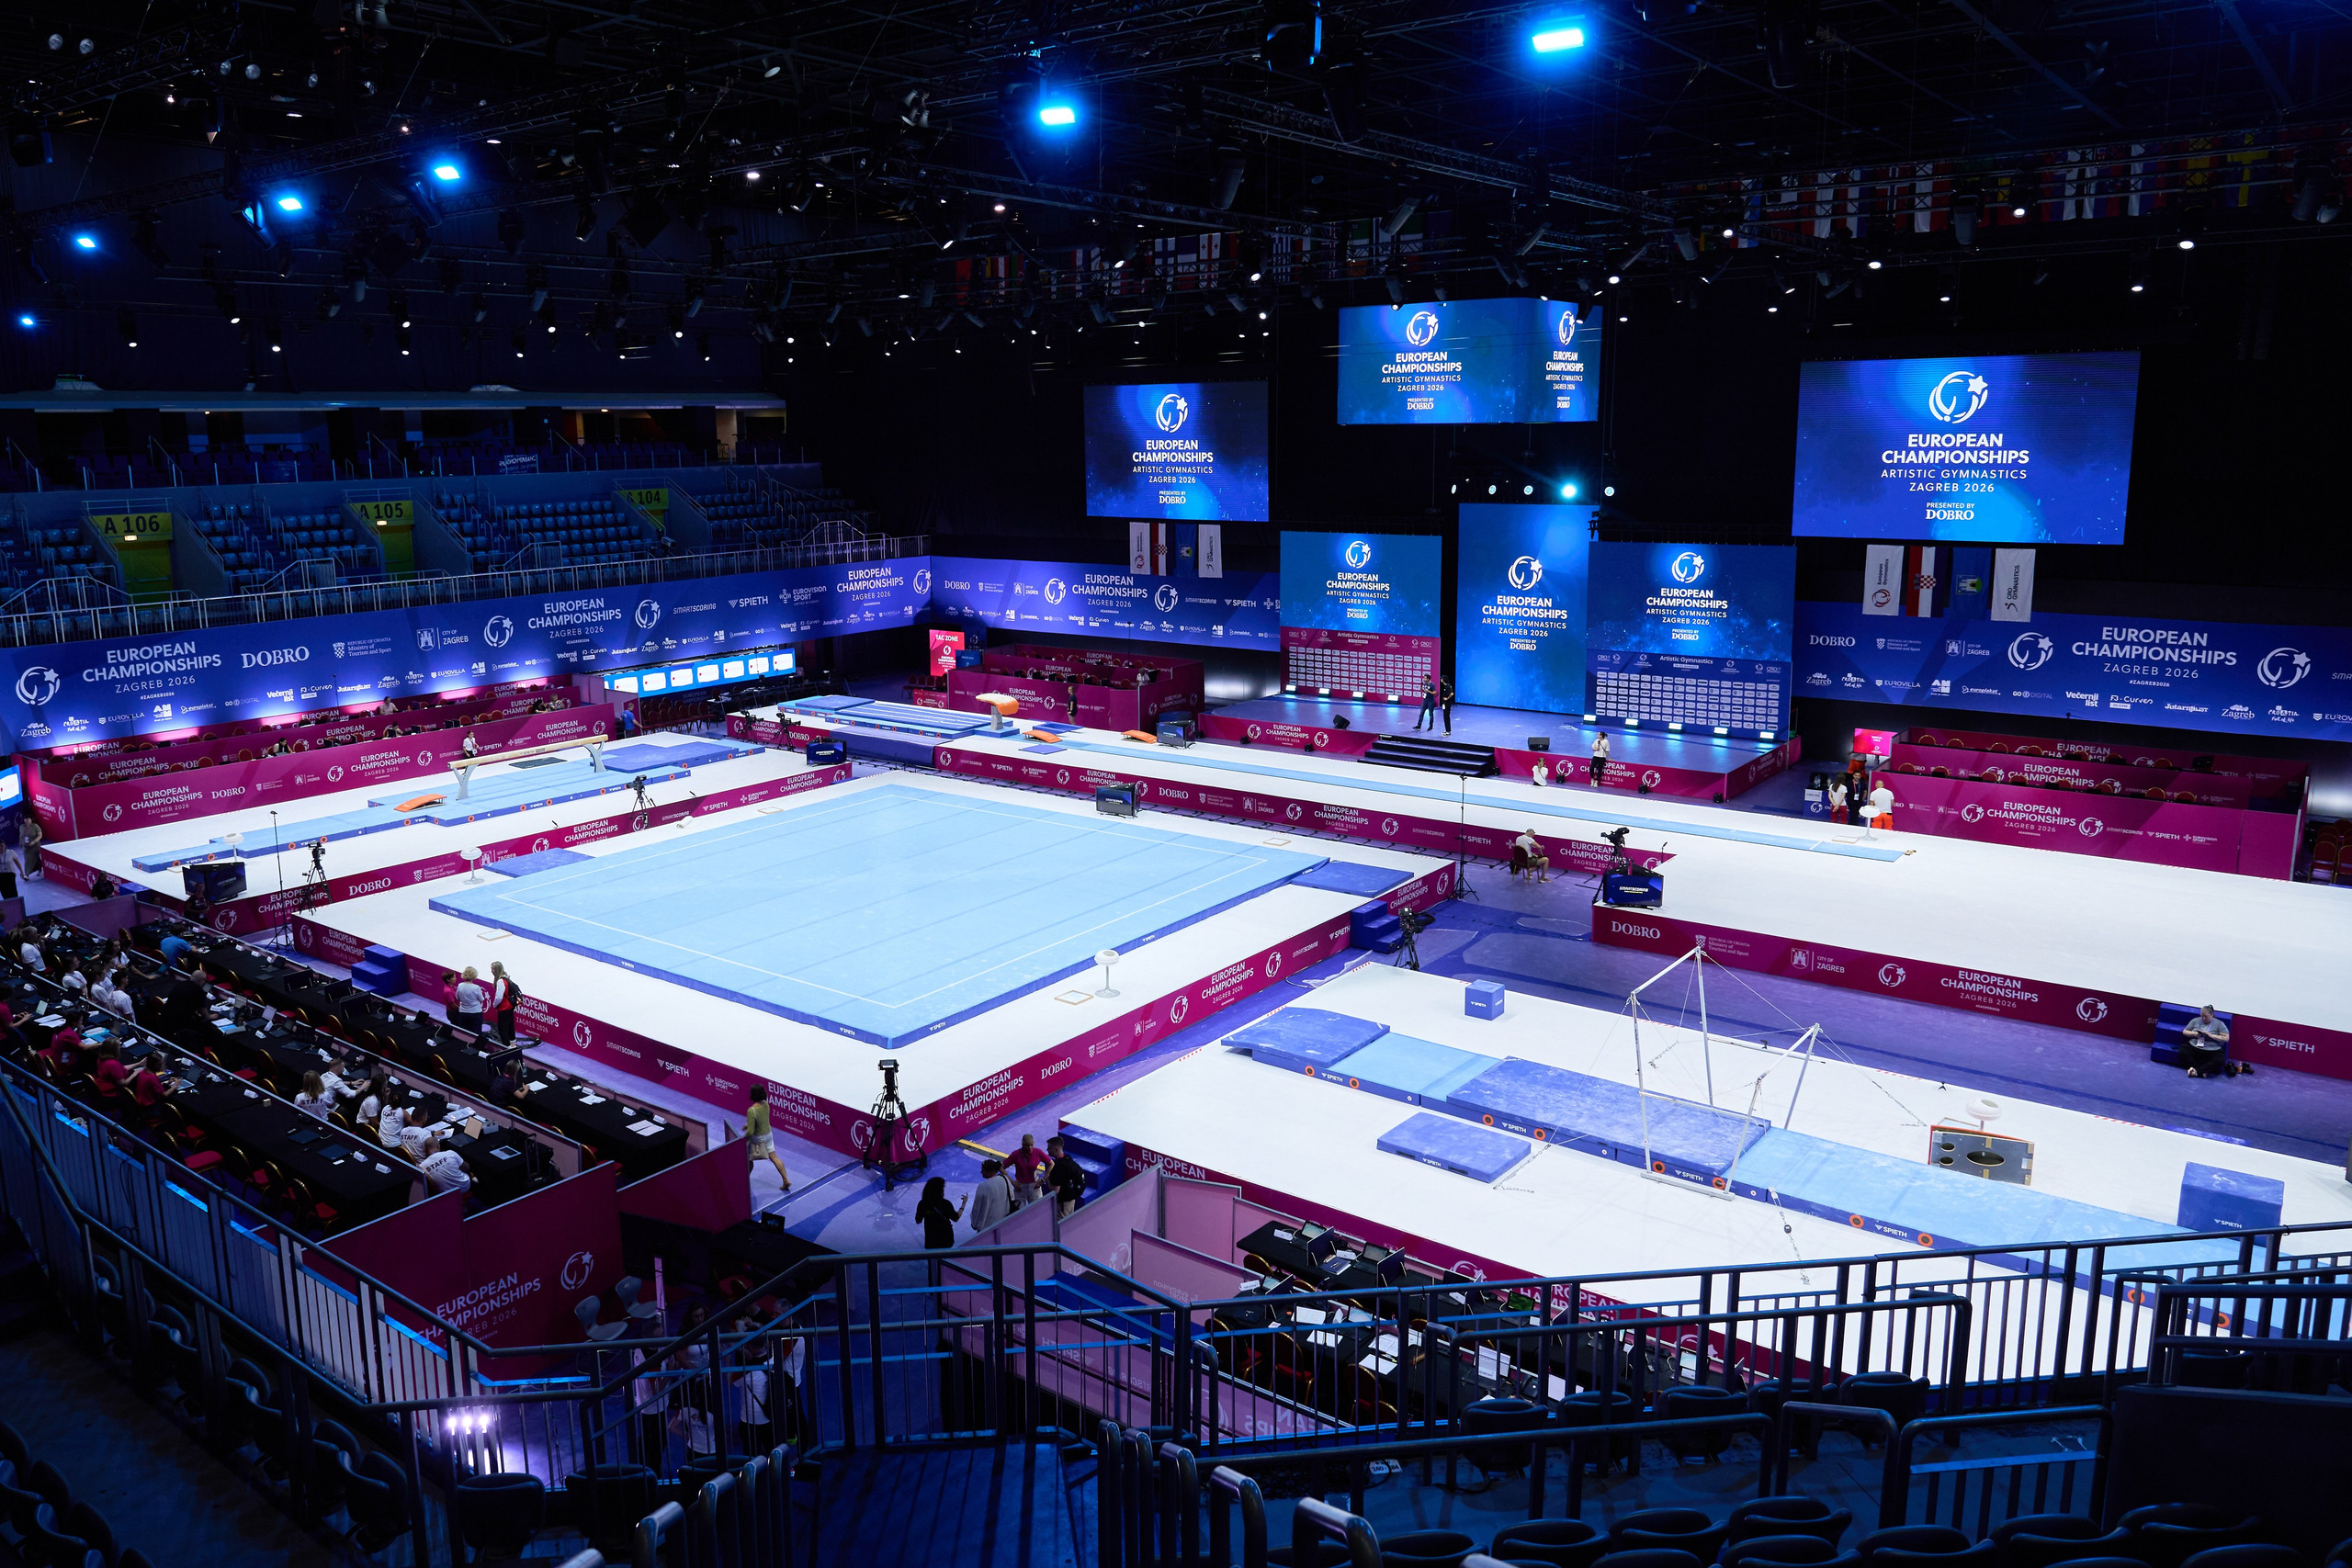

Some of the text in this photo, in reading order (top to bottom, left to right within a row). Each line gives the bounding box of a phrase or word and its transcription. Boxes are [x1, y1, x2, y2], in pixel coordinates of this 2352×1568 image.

[1396, 352, 1448, 363] EUROPEAN
[1382, 362, 1462, 374] CHAMPIONSHIPS
[1147, 440, 1198, 450] EUROPEAN
[1908, 434, 2003, 447] EUROPEAN
[1132, 452, 1214, 463] CHAMPIONSHIPS
[1882, 450, 2030, 464] CHAMPIONSHIPS
[1882, 468, 2027, 479] ARTISTIC GYMNASTICS
[1909, 483, 1995, 492] ZAGREB 2026
[638, 491, 661, 504] 104
[1159, 496, 1186, 504] DOBRO
[359, 503, 403, 520] A 105
[1926, 509, 1974, 520] DOBRO
[105, 514, 161, 535] A 106
[848, 568, 892, 581] EUROPEAN
[1085, 574, 1134, 586] EUROPEAN
[1338, 572, 1378, 581] EUROPEAN
[837, 577, 904, 592] CHAMPIONSHIPS
[944, 581, 970, 590] DOBRO
[1072, 584, 1148, 598] CHAMPIONSHIPS
[1327, 581, 1390, 591] CHAMPIONSHIPS
[794, 593, 812, 602] SPORT
[1661, 588, 1713, 599] EUROPEAN
[544, 598, 605, 614] EUROPEAN
[739, 595, 769, 607] SPIETH
[1233, 599, 1256, 608] SPIETH
[1498, 595, 1552, 607] EUROPEAN
[1646, 597, 1728, 609] CHAMPIONSHIPS
[673, 603, 717, 615] SMARTSCORING
[1482, 606, 1567, 619] CHAMPIONSHIPS
[1646, 608, 1727, 618] ARTISTIC GYMNASTICS
[527, 608, 622, 629] CHAMPIONSHIPS
[1482, 617, 1566, 629] ARTISTIC GYMNASTICS
[549, 626, 604, 638] ZAGREB 2026
[2102, 626, 2208, 647] EUROPEAN
[443, 636, 469, 645] ZAGREB
[1510, 643, 1536, 651] DOBRO
[1810, 635, 1856, 647] DOBRO
[107, 641, 196, 663] EUROPEAN
[241, 646, 310, 669] DOBRO
[2072, 642, 2237, 665] CHAMPIONSHIPS
[83, 654, 221, 682] CHAMPIONSHIPS
[2104, 663, 2199, 679] ZAGREB 2026
[116, 675, 196, 694] ZAGREB 2026
[378, 679, 401, 689] Zagreb
[1806, 676, 1832, 685] Zagreb
[2222, 708, 2255, 720] Zagreb
[537, 725, 587, 739] CHAMPIONSHIPS
[546, 720, 578, 731] EUROPEAN
[1273, 724, 1301, 732] EUROPEAN
[20, 727, 51, 738] Zagreb
[1266, 729, 1309, 739] CHAMPIONSHIPS
[483, 742, 503, 751] SPIETH
[360, 750, 400, 763] EUROPEAN
[351, 755, 411, 772] CHAMPIONSHIPS
[2024, 764, 2079, 777] EUROPEAN
[787, 773, 815, 784] EUROPEAN
[143, 784, 189, 799] EUROPEAN
[211, 785, 245, 799] DOBRO
[1159, 787, 1189, 800] DOBRO
[130, 791, 203, 810] CHAMPIONSHIPS
[709, 801, 728, 811] SPIETH
[1323, 805, 1359, 816] EUROPEAN
[2004, 801, 2061, 815] EUROPEAN
[1314, 810, 1369, 825] CHAMPIONSHIPS
[1987, 808, 2076, 826] CHAMPIONSHIPS
[573, 819, 608, 833] EUROPEAN
[564, 825, 618, 842] CHAMPIONSHIPS
[1468, 836, 1491, 845] SPIETH
[349, 878, 391, 897] DOBRO
[1334, 925, 1351, 939] SPIETH
[1611, 920, 1660, 940] DOBRO
[1709, 941, 1727, 949] Ministry
[1211, 962, 1246, 985] EUROPEAN
[1817, 963, 1845, 974] ZAGREB
[1202, 968, 1254, 999] CHAMPIONSHIPS
[1959, 970, 2021, 989] EUROPEAN
[1213, 985, 1243, 1004] ZAGREB 2026
[1940, 977, 2039, 1003] CHAMPIONSHIPS
[1960, 992, 2017, 1009] ZAGREB 2026
[606, 1040, 641, 1059] SMARTSCORING
[2269, 1036, 2314, 1054] SPIETH
[665, 1062, 689, 1077] SPIETH
[1041, 1057, 1072, 1079] DOBRO
[963, 1070, 1011, 1100] EUROPEAN
[1327, 1075, 1343, 1083] SPIETH
[768, 1082, 816, 1108] EUROPEAN
[949, 1077, 1023, 1120] CHAMPIONSHIPS
[967, 1099, 1009, 1123] ZAGREB 2026
[1509, 1124, 1527, 1134] SPIETH
[426, 1156, 448, 1173] STAFF
[1142, 1150, 1205, 1179] EUROPEAN
[1682, 1172, 1703, 1182] SPIETH
[2222, 1220, 2242, 1229] SPIETH
[1883, 1227, 1907, 1237] SPIETH
[436, 1271, 518, 1318] EUROPEAN
